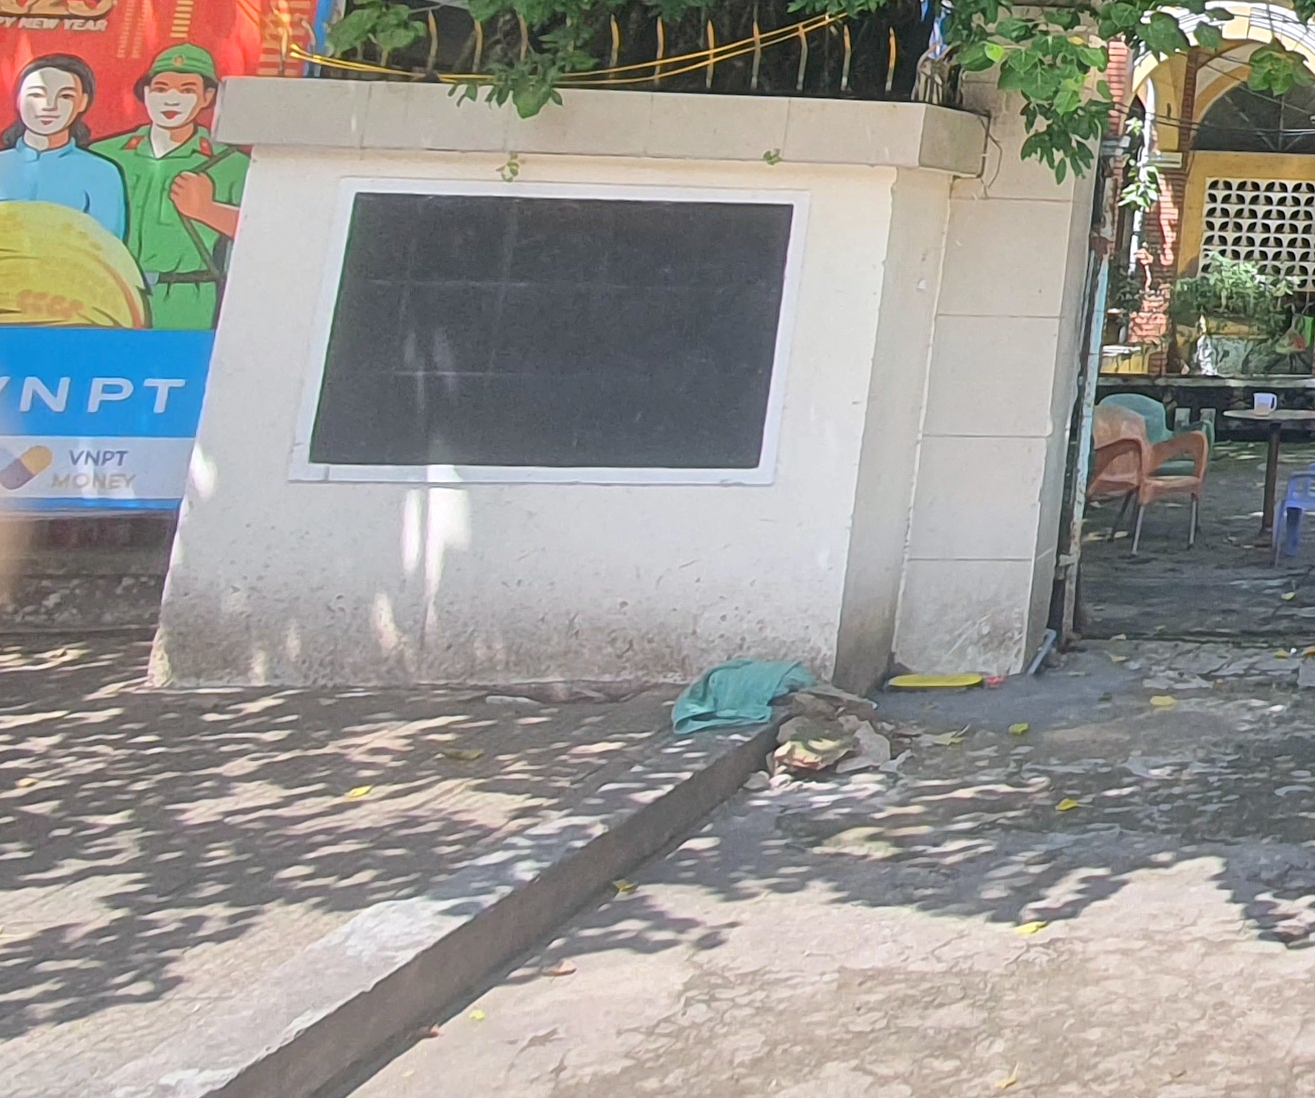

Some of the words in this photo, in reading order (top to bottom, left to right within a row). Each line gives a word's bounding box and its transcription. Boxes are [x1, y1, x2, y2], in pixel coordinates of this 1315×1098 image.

[19, 16, 62, 30] NEW
[63, 17, 109, 32] YEAR
[0, 376, 187, 414] NPT
[68, 449, 129, 467] VNPT
[51, 472, 137, 490] MONEY
